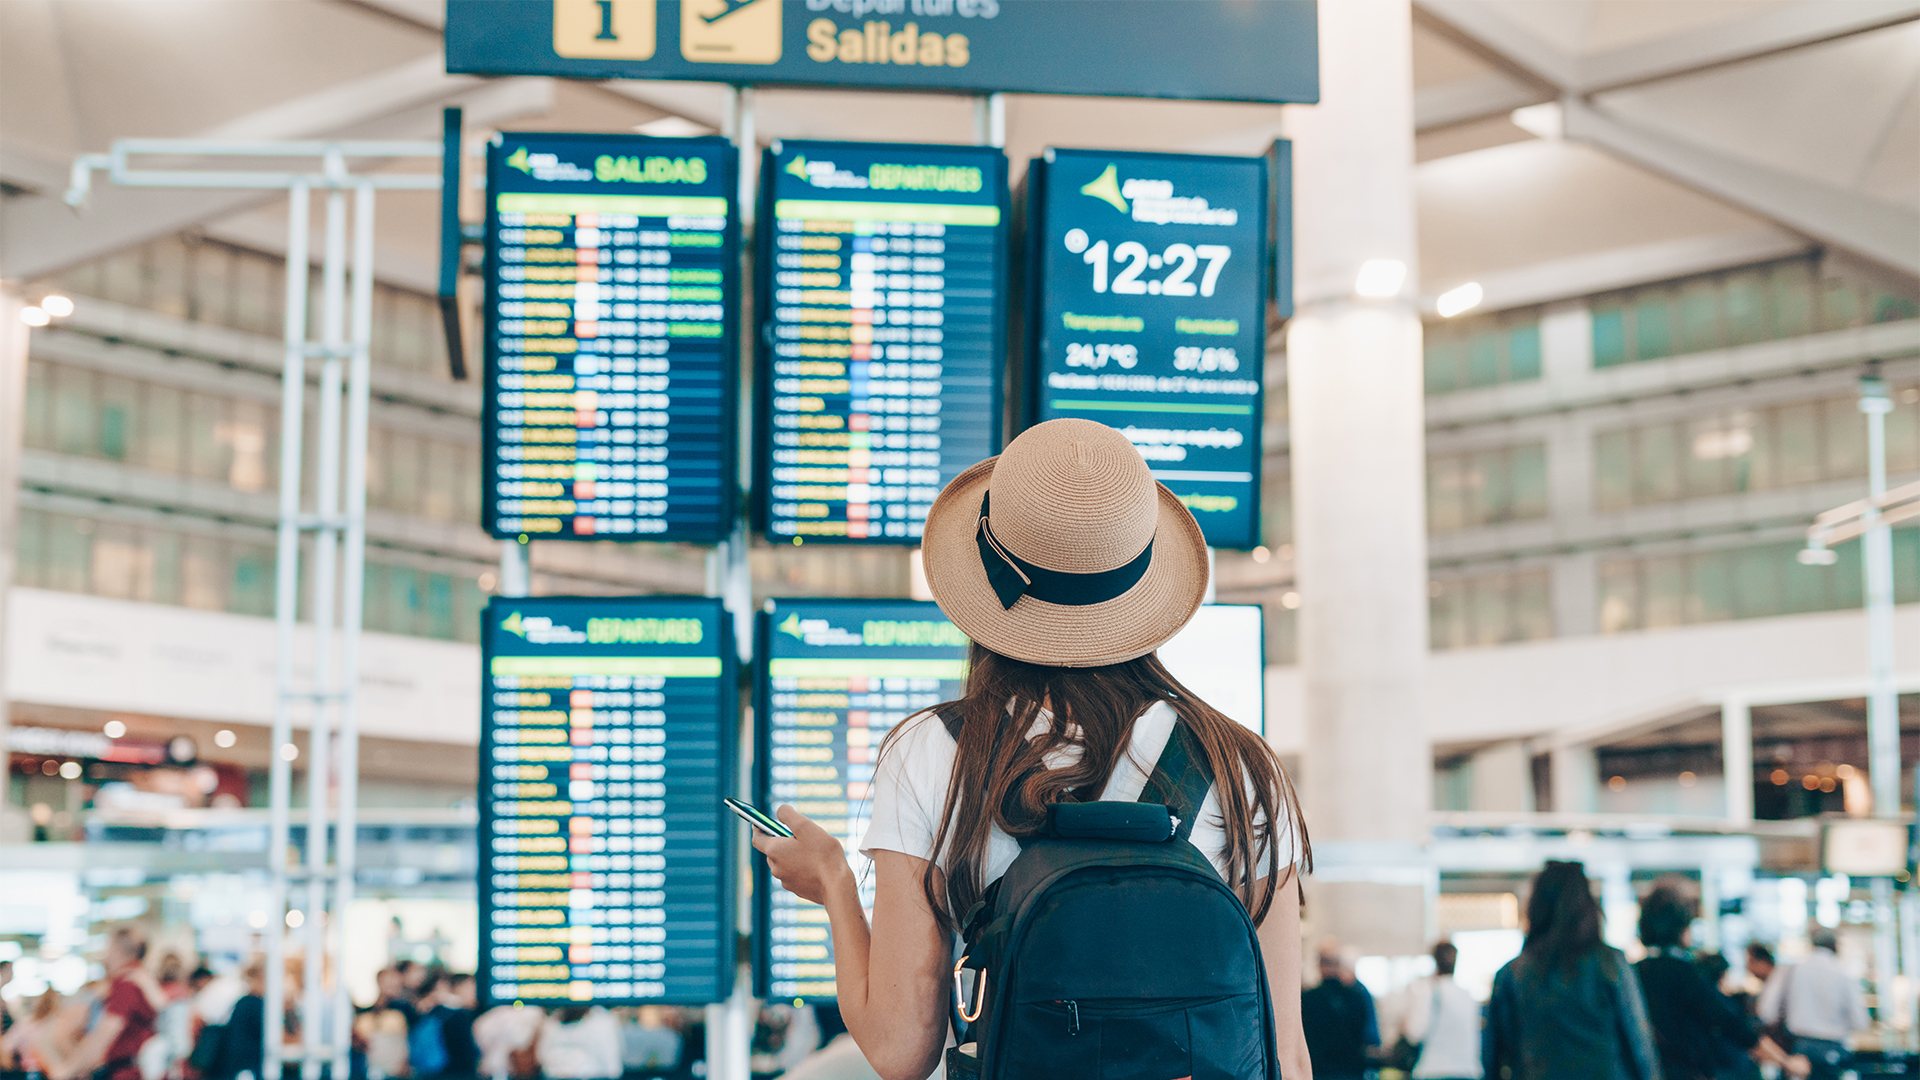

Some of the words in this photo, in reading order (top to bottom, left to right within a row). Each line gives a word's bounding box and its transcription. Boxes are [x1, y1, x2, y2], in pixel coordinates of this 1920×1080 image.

[806, 18, 970, 67] Salidas
[595, 154, 708, 184] SALIDAS
[869, 163, 982, 192] DEPARTURES
[1083, 239, 1232, 298] 12:27
[587, 617, 704, 645] DEPARTURES
[863, 620, 973, 646] DEPARTURE
